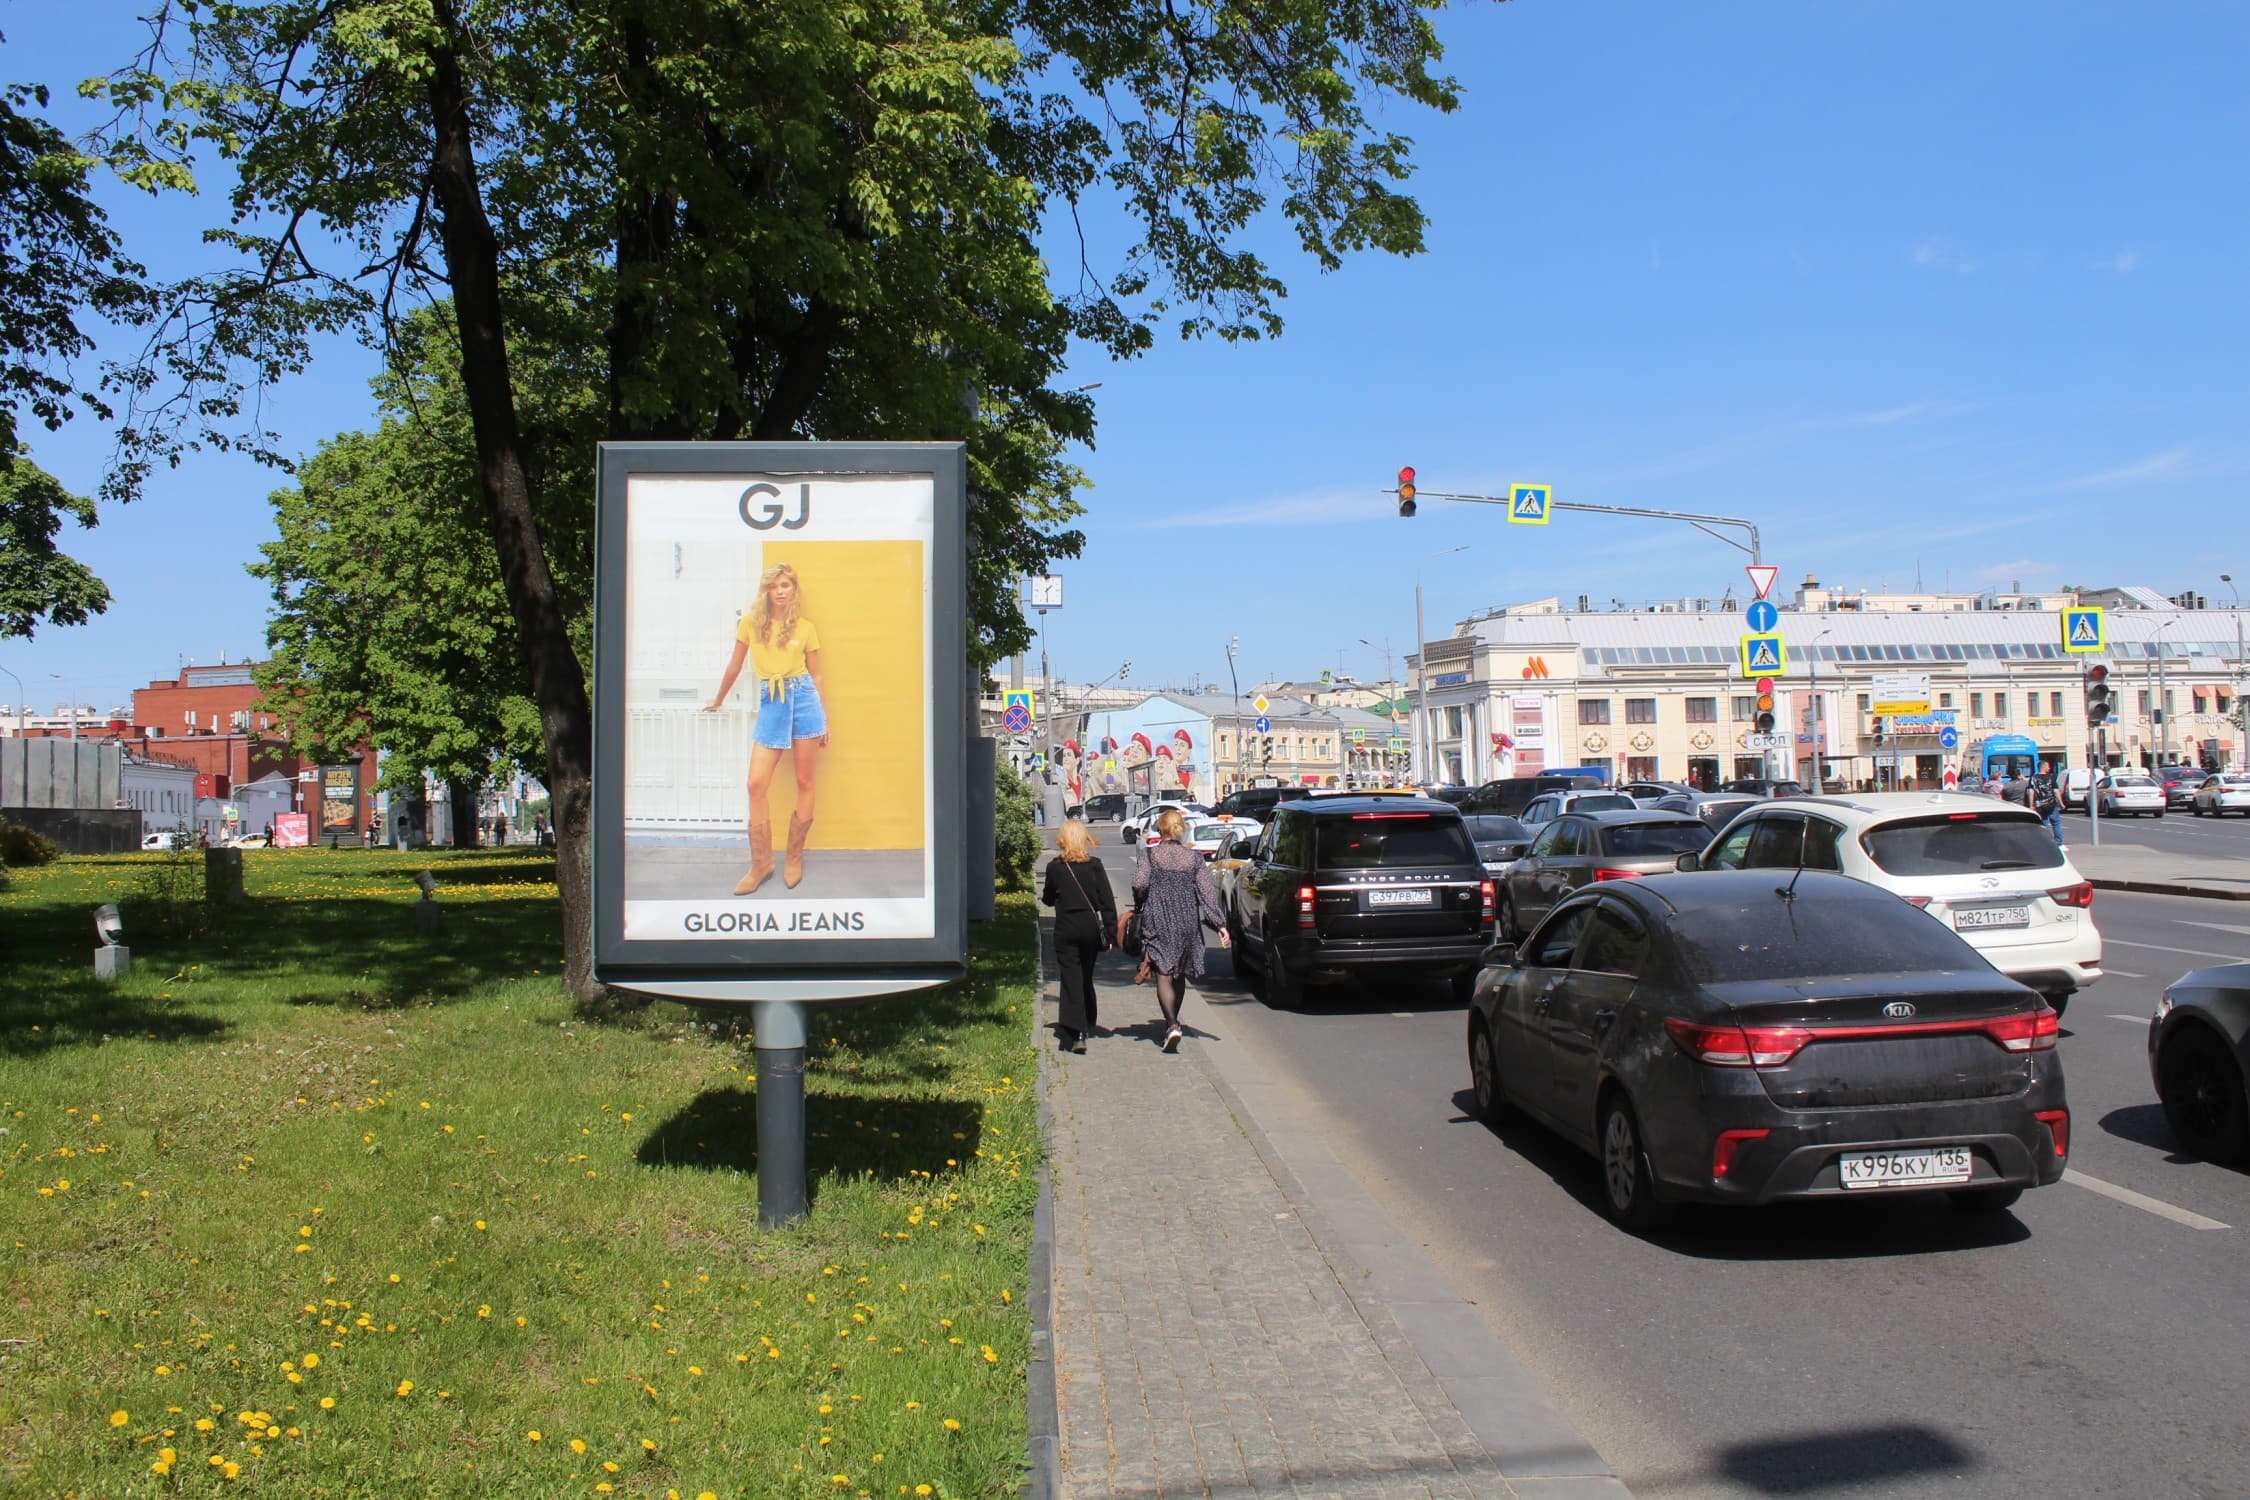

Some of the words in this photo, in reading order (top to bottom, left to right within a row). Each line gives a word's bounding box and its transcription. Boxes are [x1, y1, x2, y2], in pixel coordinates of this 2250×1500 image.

[739, 483, 810, 530] GJ
[1753, 735, 1786, 746] СТОП
[684, 913, 779, 932] GLORIA
[788, 911, 865, 931] JEANS
[1889, 1005, 1913, 1017] KIA
[1849, 1154, 1929, 1178] К996КУ
